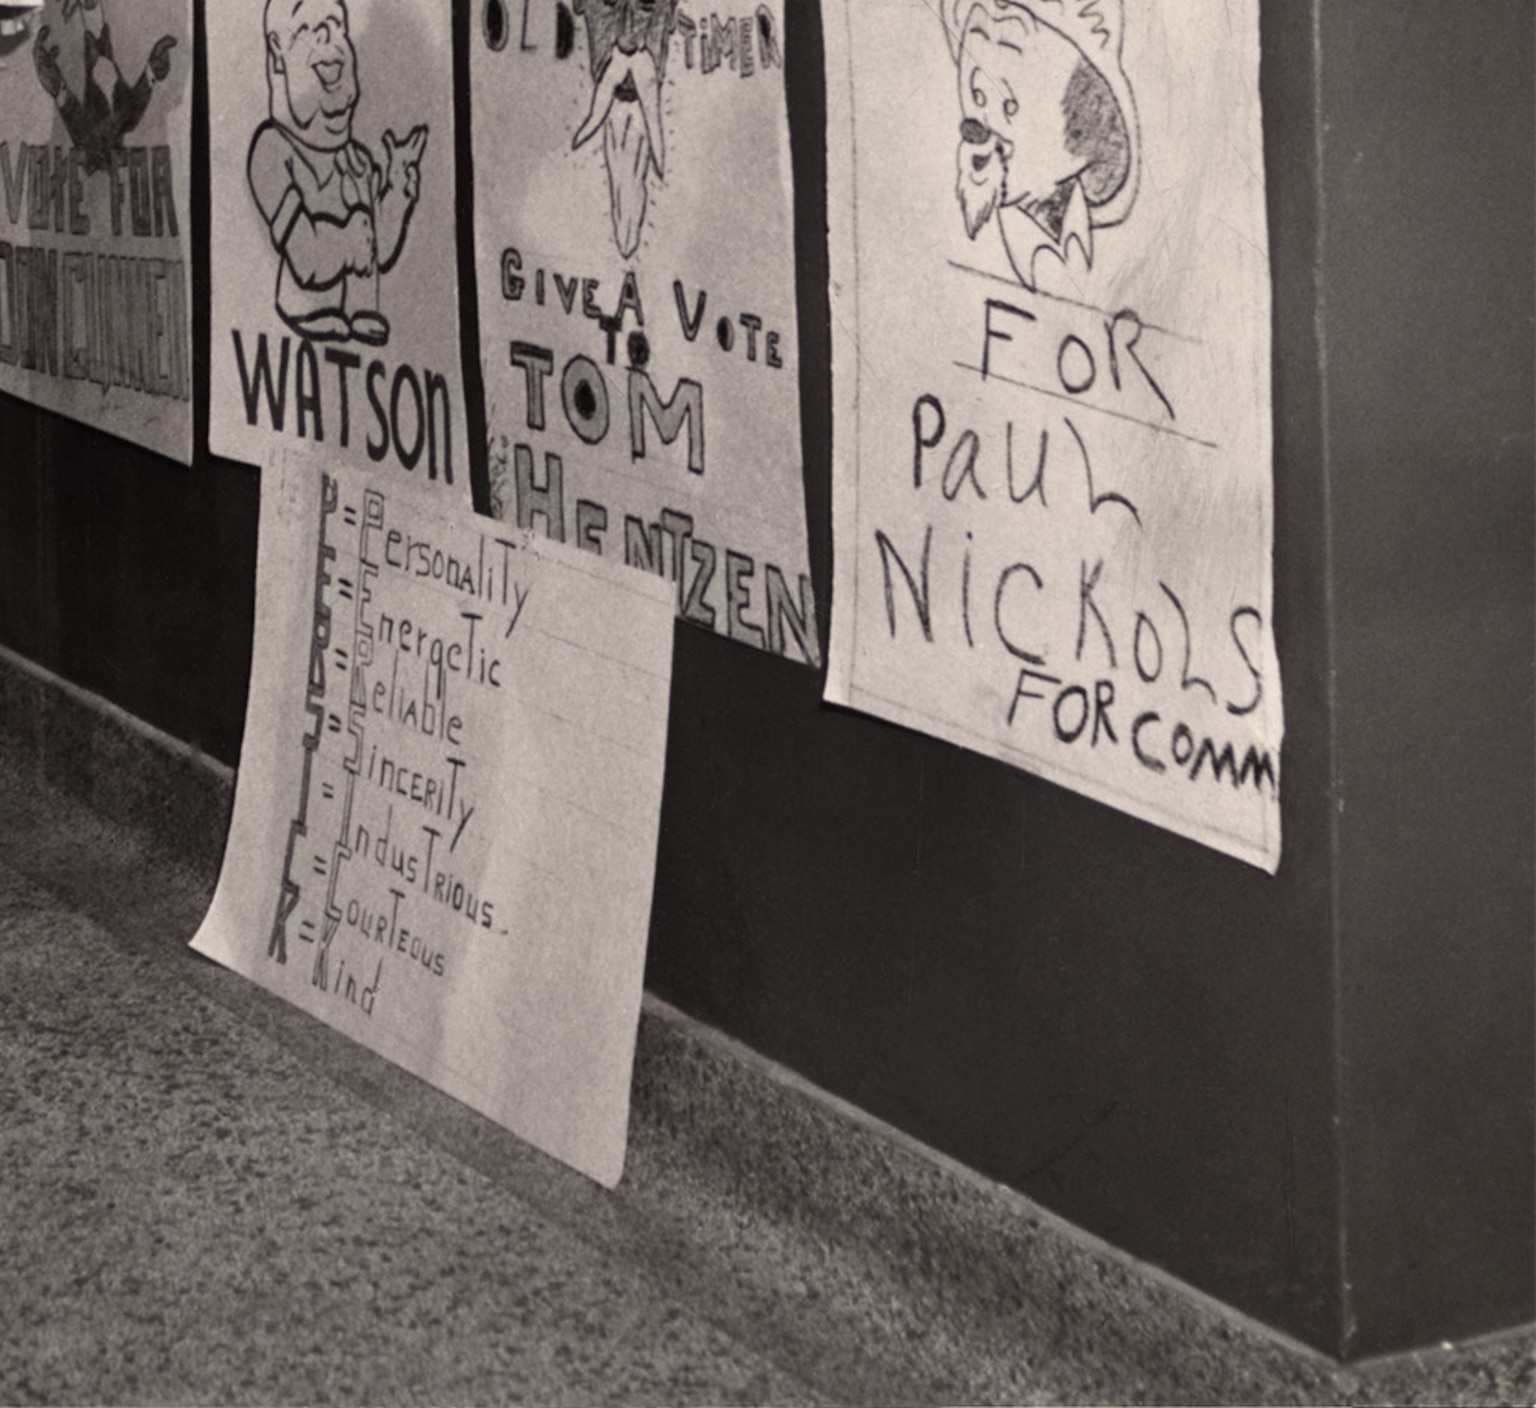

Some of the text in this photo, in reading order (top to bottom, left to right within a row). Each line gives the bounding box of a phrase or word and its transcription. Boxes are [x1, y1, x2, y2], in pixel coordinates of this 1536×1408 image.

[108, 145, 181, 238] FOR
[500, 247, 784, 369] GIVE A VOTE
[599, 314, 652, 368] TO
[980, 297, 1177, 421] FOR
[229, 329, 454, 486] WATSON
[509, 339, 705, 476] TOM
[513, 443, 822, 670] HENTZEN
[1005, 668, 1120, 749] FOR
